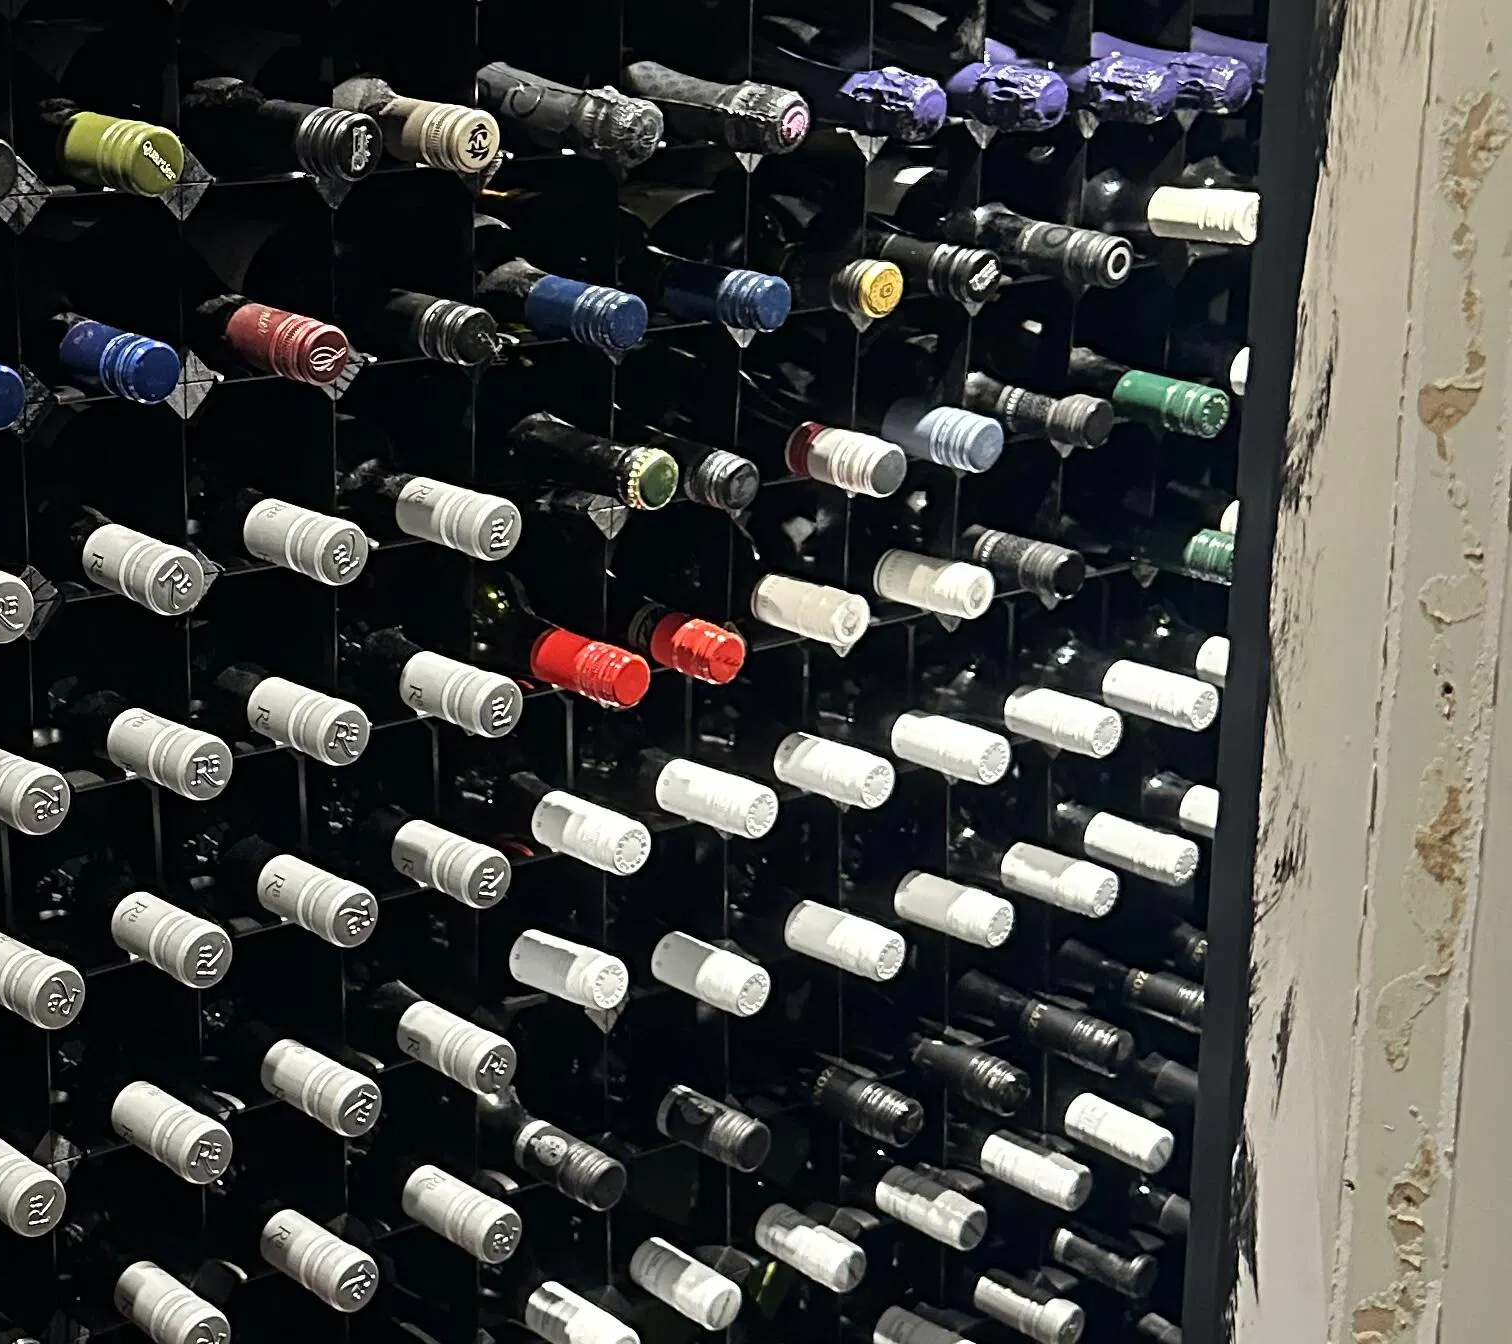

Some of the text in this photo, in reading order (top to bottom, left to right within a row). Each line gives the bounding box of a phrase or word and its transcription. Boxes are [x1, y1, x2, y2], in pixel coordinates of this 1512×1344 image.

[489, 511, 517, 550] RB
[157, 560, 193, 609] RB
[491, 688, 518, 729] RB
[328, 720, 360, 757] RB
[190, 753, 225, 788] RB
[27, 784, 65, 822] RB
[478, 865, 506, 899] RB
[195, 940, 227, 978] RB
[47, 976, 82, 1016] RB
[343, 1089, 378, 1124] RB
[190, 1139, 222, 1176] RB
[26, 1188, 57, 1227] RB
[339, 1264, 377, 1300] RB
